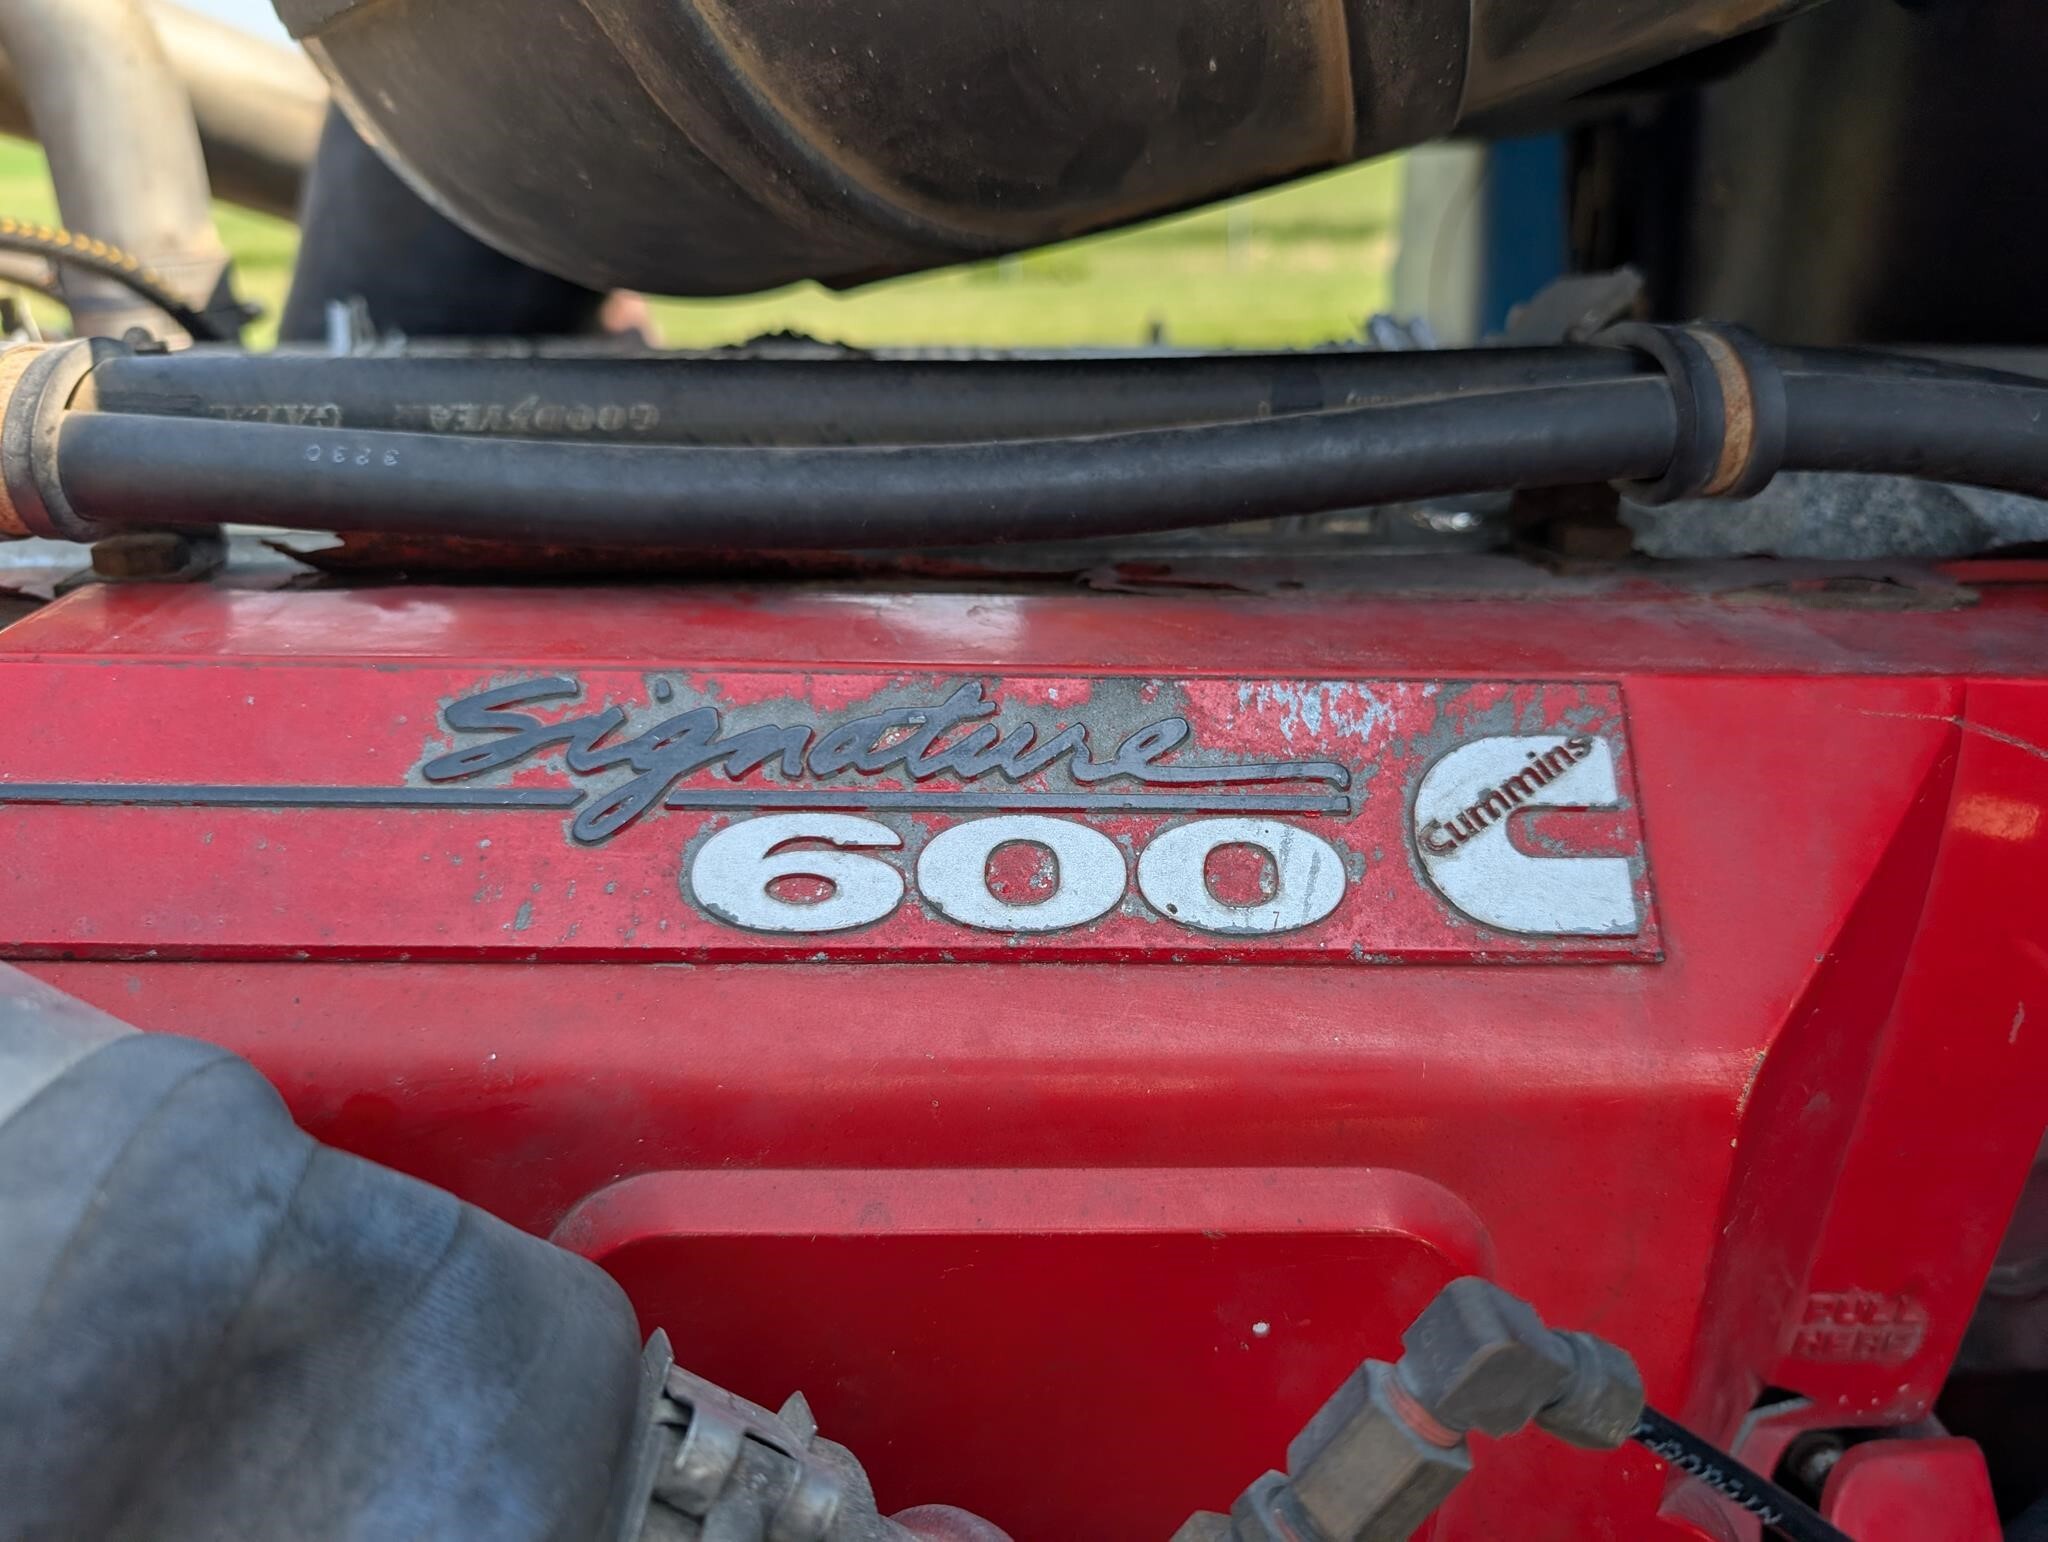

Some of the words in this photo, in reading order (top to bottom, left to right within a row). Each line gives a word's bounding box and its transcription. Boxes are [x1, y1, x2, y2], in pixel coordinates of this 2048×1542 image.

[421, 677, 1352, 845] Signature
[1417, 735, 1593, 855] Cummins
[689, 813, 1348, 934] 600
